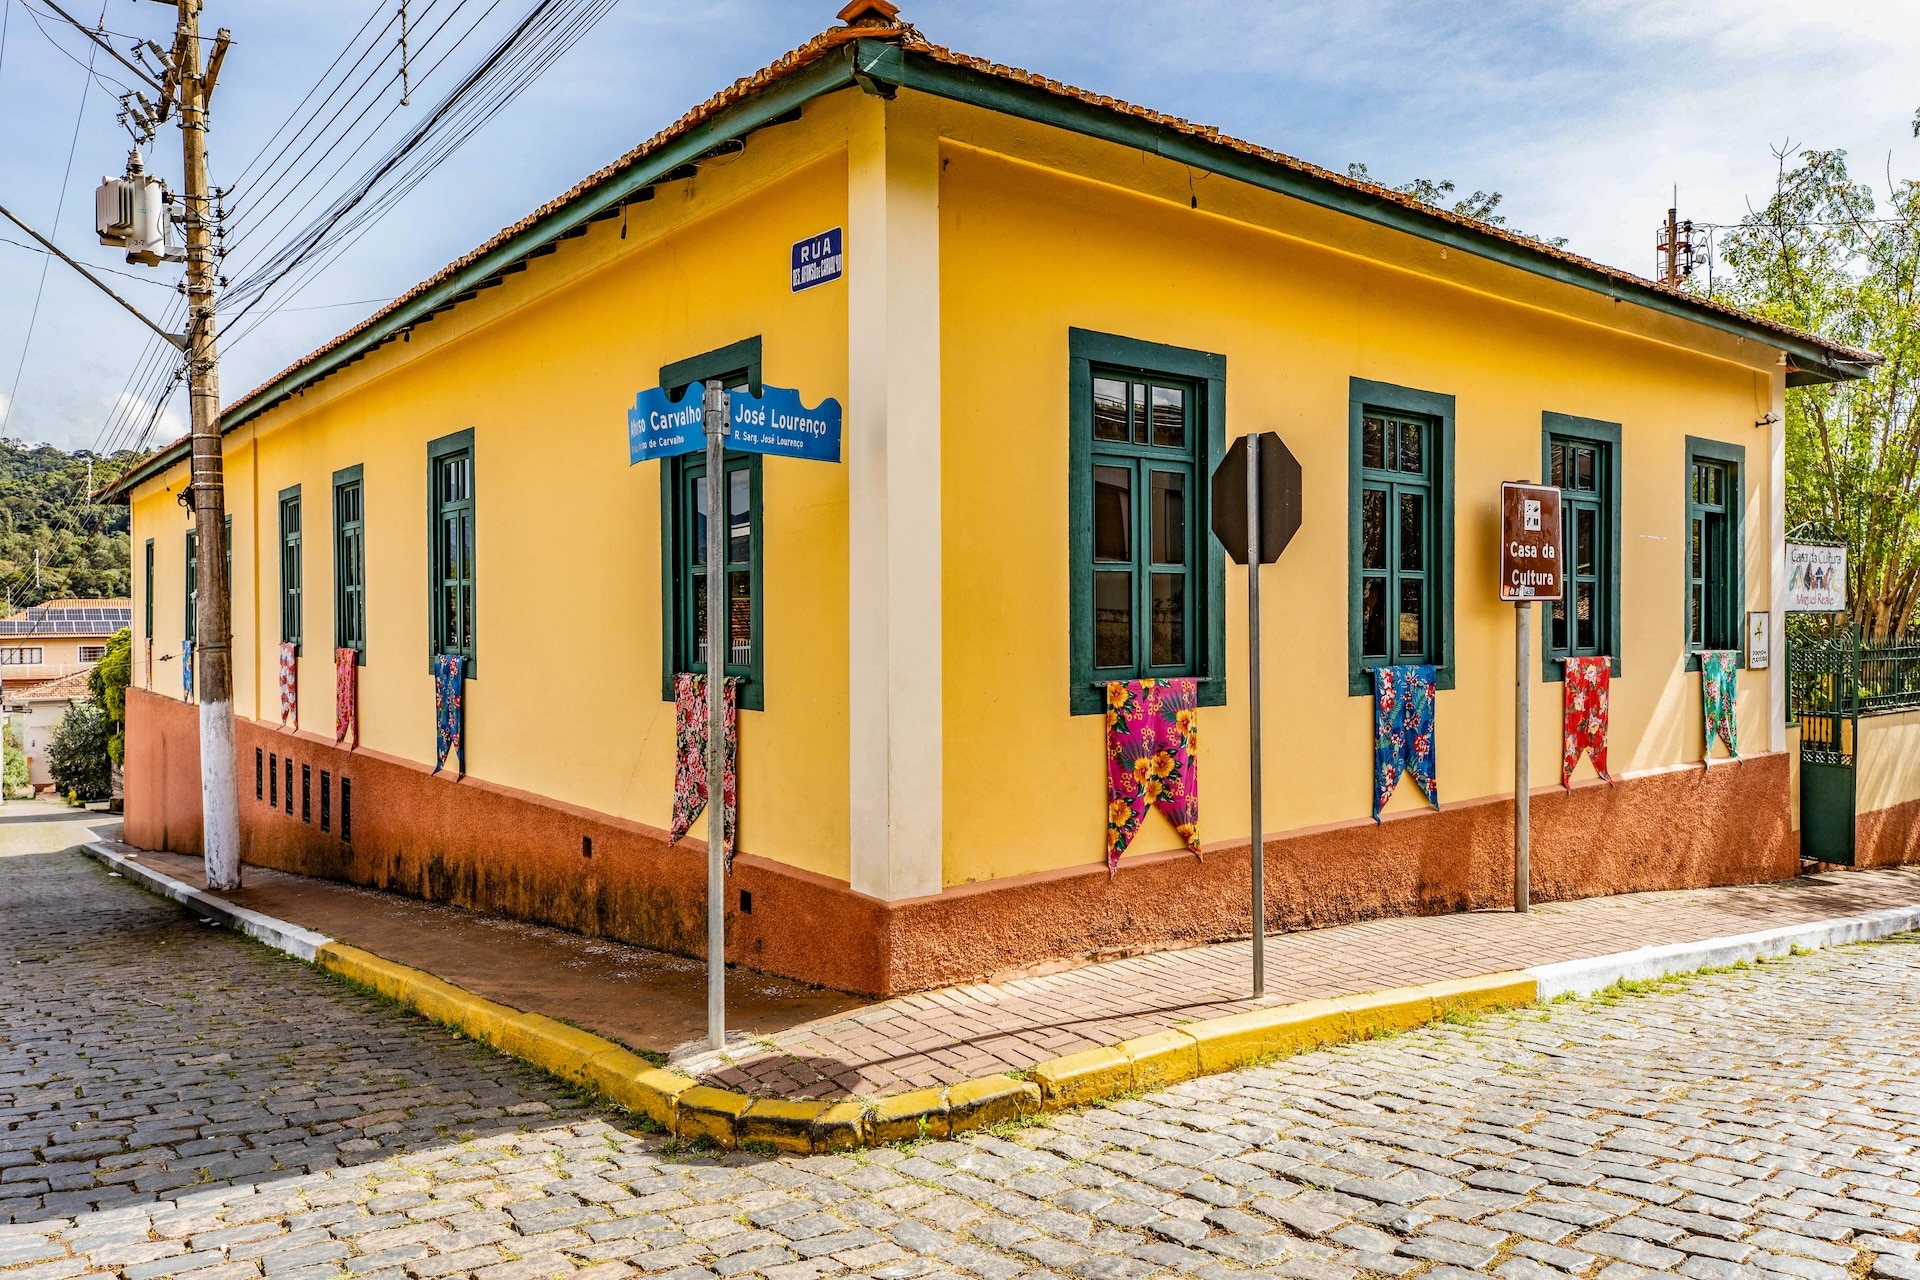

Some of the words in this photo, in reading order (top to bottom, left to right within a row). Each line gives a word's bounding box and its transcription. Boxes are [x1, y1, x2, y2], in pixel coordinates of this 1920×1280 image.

[801, 237, 831, 262] RUA
[650, 405, 702, 431] Carvalho
[735, 403, 766, 426] José
[771, 409, 827, 439] Lourenço
[649, 438, 657, 448] de
[659, 435, 684, 447] Carvalho
[734, 430, 741, 440] R.
[742, 431, 758, 444] Sarg.
[760, 434, 775, 445] José
[776, 436, 804, 450] Lourenço
[1510, 541, 1537, 558] Casa
[1542, 542, 1555, 559] da
[1791, 549, 1808, 564] Casa
[1809, 547, 1818, 563] da
[1818, 550, 1842, 565] Cultura
[1511, 569, 1553, 585] Cultura
[1796, 591, 1817, 609] Miguel
[1818, 593, 1834, 605] Reale
